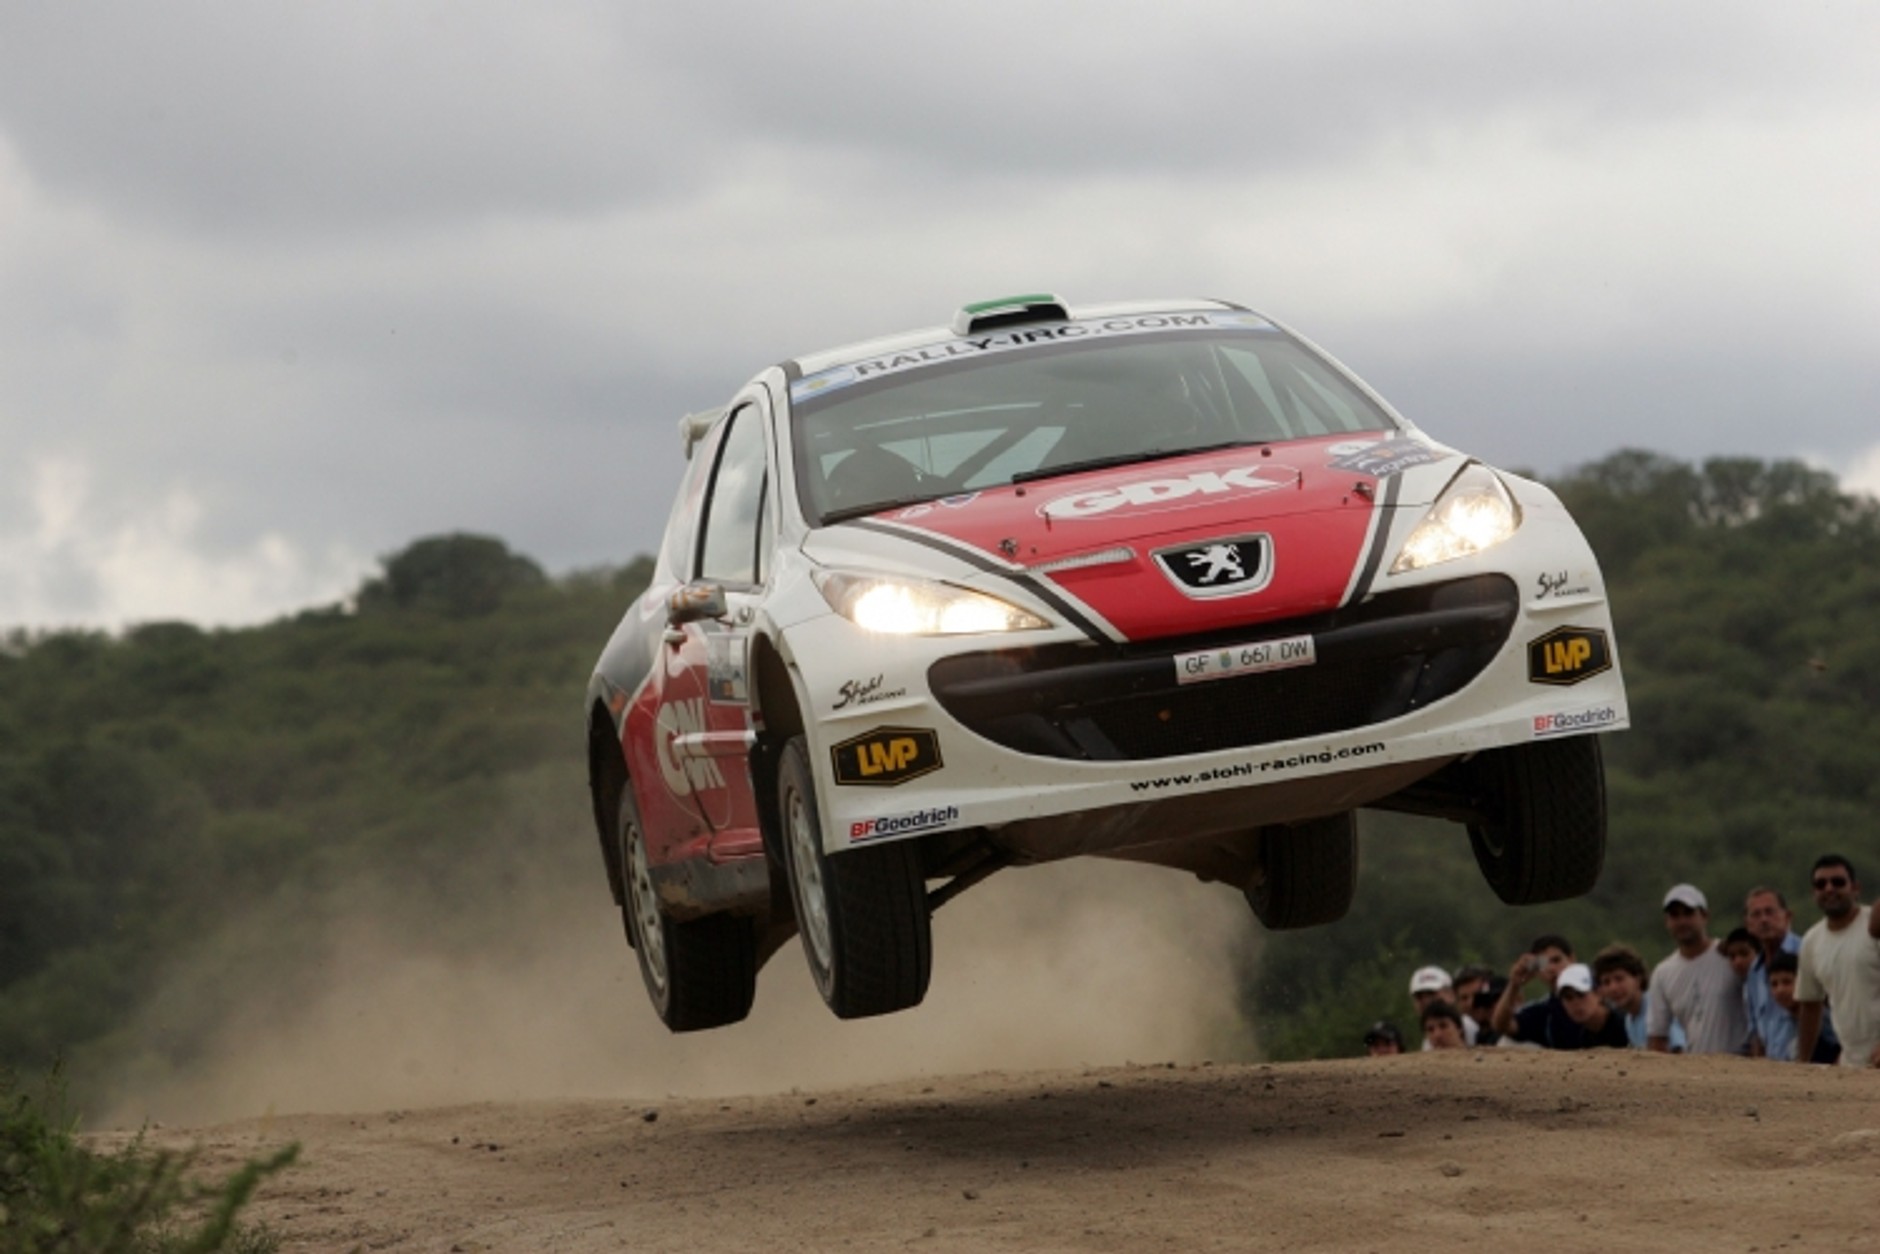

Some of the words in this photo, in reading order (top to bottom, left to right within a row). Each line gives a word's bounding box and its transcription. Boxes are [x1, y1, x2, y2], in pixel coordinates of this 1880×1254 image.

[855, 313, 1211, 376] RALLY-IRC.COM
[1044, 465, 1281, 517] GDK
[1280, 639, 1308, 660] DW
[1543, 637, 1591, 673] LMP
[1534, 707, 1615, 731] BFGoodrich
[856, 737, 919, 776] LMP
[1130, 741, 1386, 792] www.stohl-racing.com
[850, 805, 959, 838] BFGoodrich
